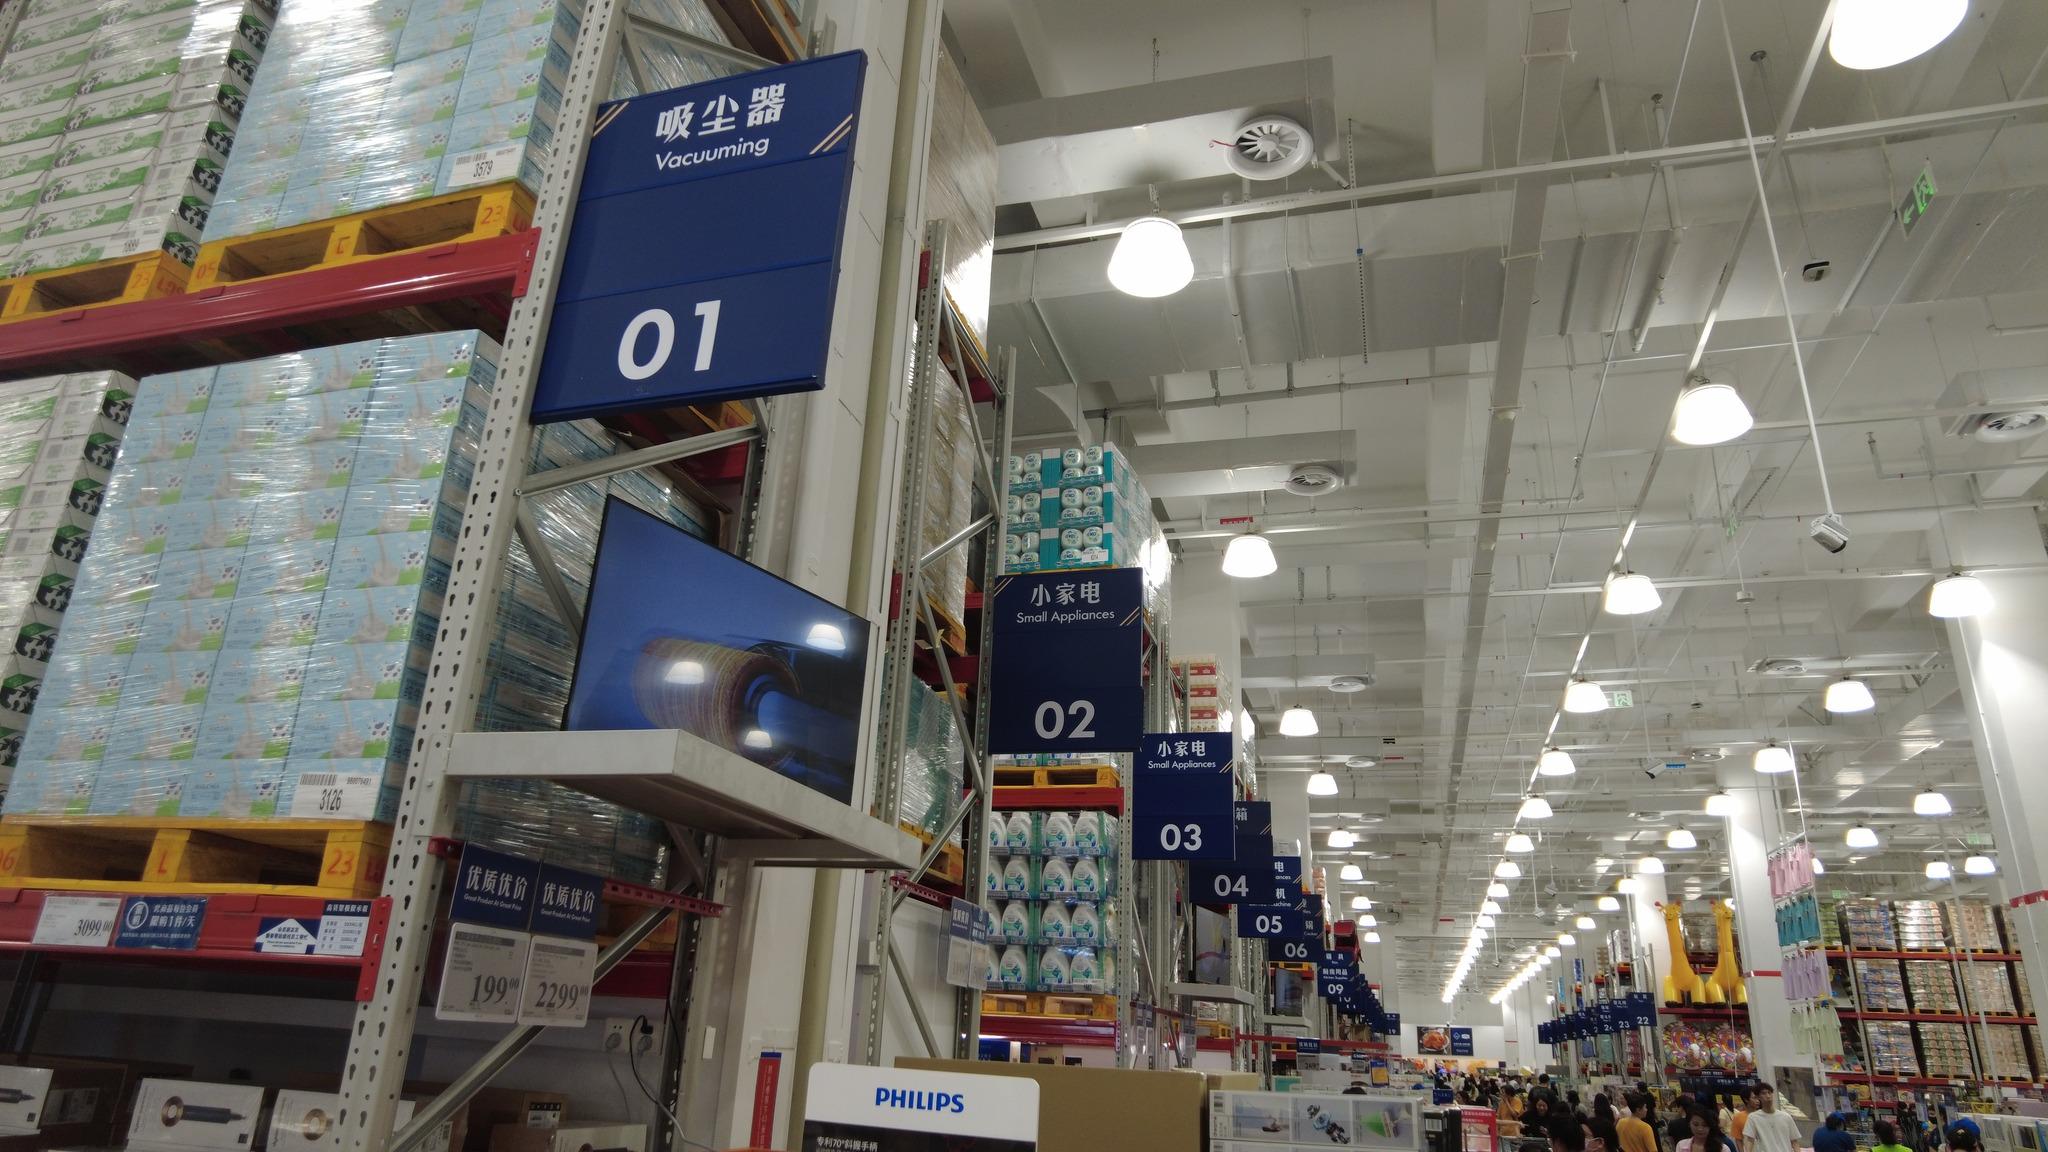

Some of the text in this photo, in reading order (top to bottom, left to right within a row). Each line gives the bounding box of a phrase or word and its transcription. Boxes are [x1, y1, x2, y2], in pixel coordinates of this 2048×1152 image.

[655, 83, 786, 144] 吸尘器
[655, 137, 770, 171] Vacuuming
[473, 160, 493, 177] 3579
[618, 300, 721, 380] 01
[1030, 581, 1100, 606] 小家电
[1017, 609, 1115, 624] Small Appliances
[1034, 699, 1096, 739] 02
[1157, 740, 1206, 757] 小家电
[1148, 760, 1216, 770] Small Appliances
[319, 788, 343, 811] 3126
[1236, 807, 1248, 821] 箱
[1160, 823, 1202, 851] 03
[327, 848, 355, 876] 23
[1274, 861, 1284, 872] 电
[466, 865, 527, 901] 优质优价
[1214, 874, 1249, 897] 04
[464, 893, 476, 901] Great
[500, 901, 512, 909] Great
[542, 882, 596, 913] 优质优价
[1275, 888, 1285, 899] 机
[1256, 915, 1283, 934] 05
[1284, 943, 1308, 958] 06
[1328, 984, 1344, 994] 09
[1619, 1021, 1630, 1029] 23
[1637, 1016, 1649, 1025] 22
[875, 1087, 965, 1113] PHILIPS
